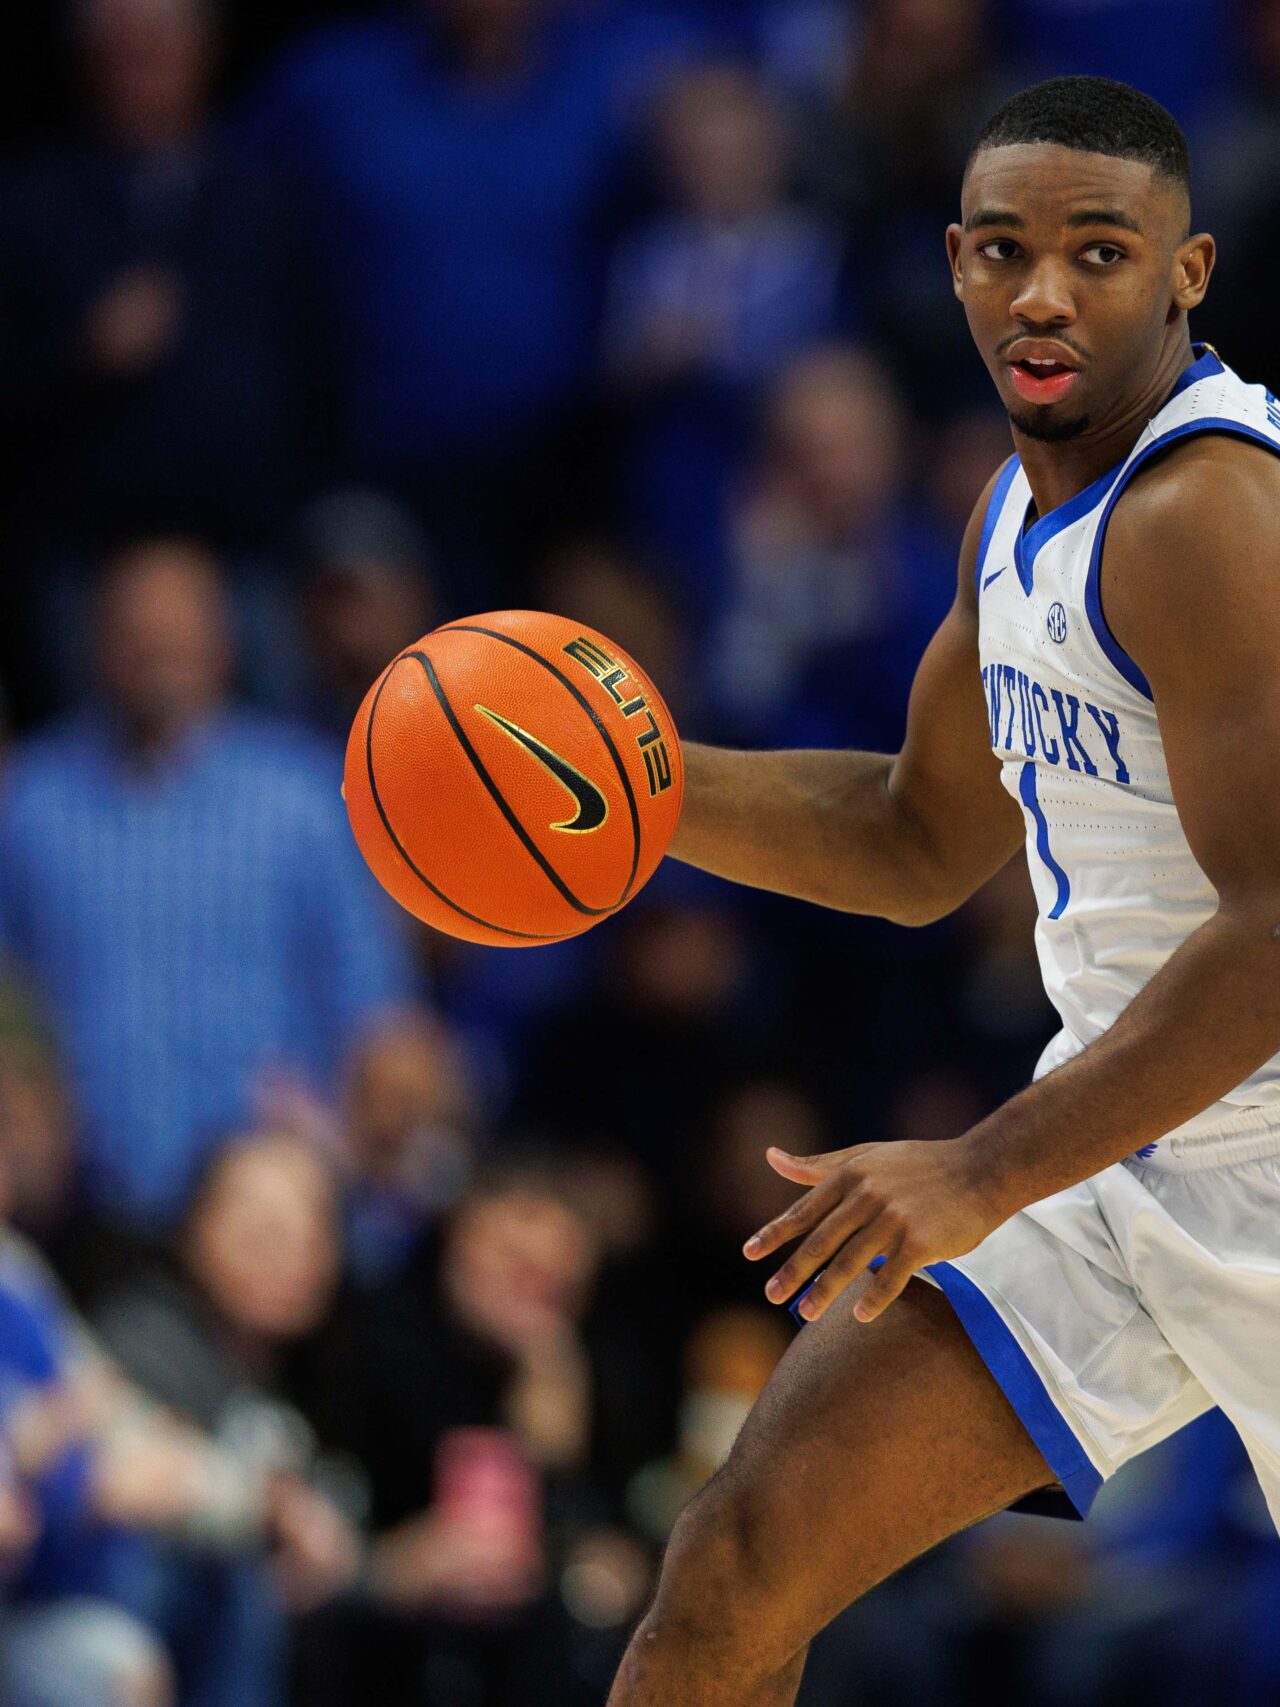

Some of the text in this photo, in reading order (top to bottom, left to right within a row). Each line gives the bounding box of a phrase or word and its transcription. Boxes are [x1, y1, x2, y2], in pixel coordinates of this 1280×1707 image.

[1048, 603, 1066, 643] SEC
[561, 636, 673, 798] ELITE
[982, 664, 1130, 784] NTUCKY
[1018, 762, 1070, 920] 1
